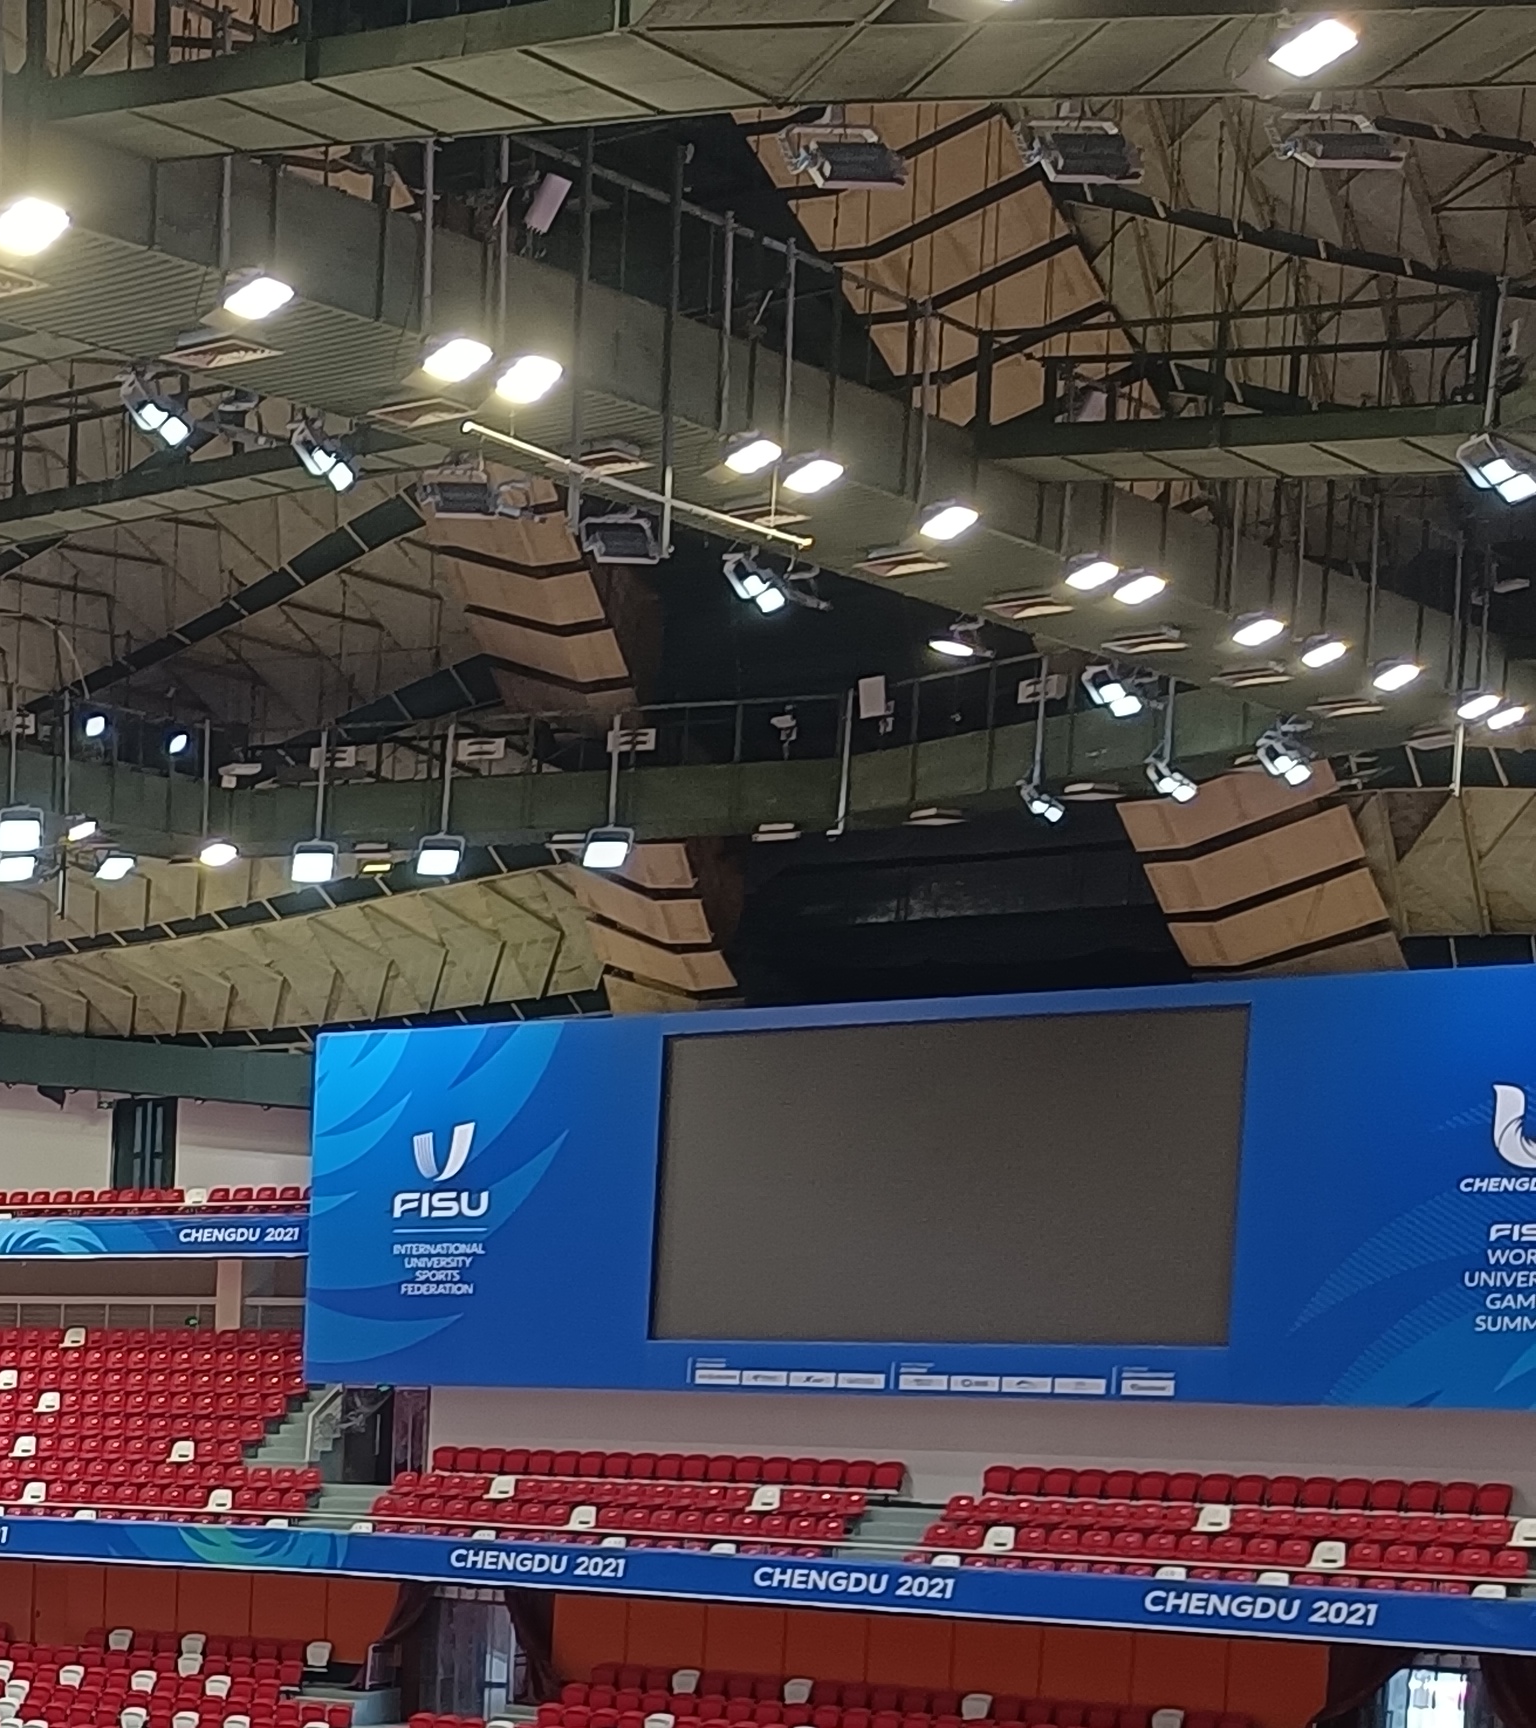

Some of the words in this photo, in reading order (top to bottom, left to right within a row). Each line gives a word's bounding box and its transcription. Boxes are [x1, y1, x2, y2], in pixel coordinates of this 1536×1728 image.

[393, 1191, 489, 1218] FISU
[178, 1227, 262, 1242] CHENGDU
[263, 1227, 300, 1241] 2021
[393, 1242, 486, 1255] INTERNATIONAL
[404, 1256, 473, 1269] UNIVERSITY
[415, 1269, 461, 1282] SPORTS
[400, 1283, 474, 1295] FEDERATION
[450, 1548, 568, 1574] CHENGDU
[573, 1556, 627, 1578] 2021
[753, 1566, 890, 1595] CHENGDU
[894, 1575, 956, 1600] 2021
[1144, 1590, 1302, 1621] CHENGDU
[1307, 1600, 1379, 1627] 2021
